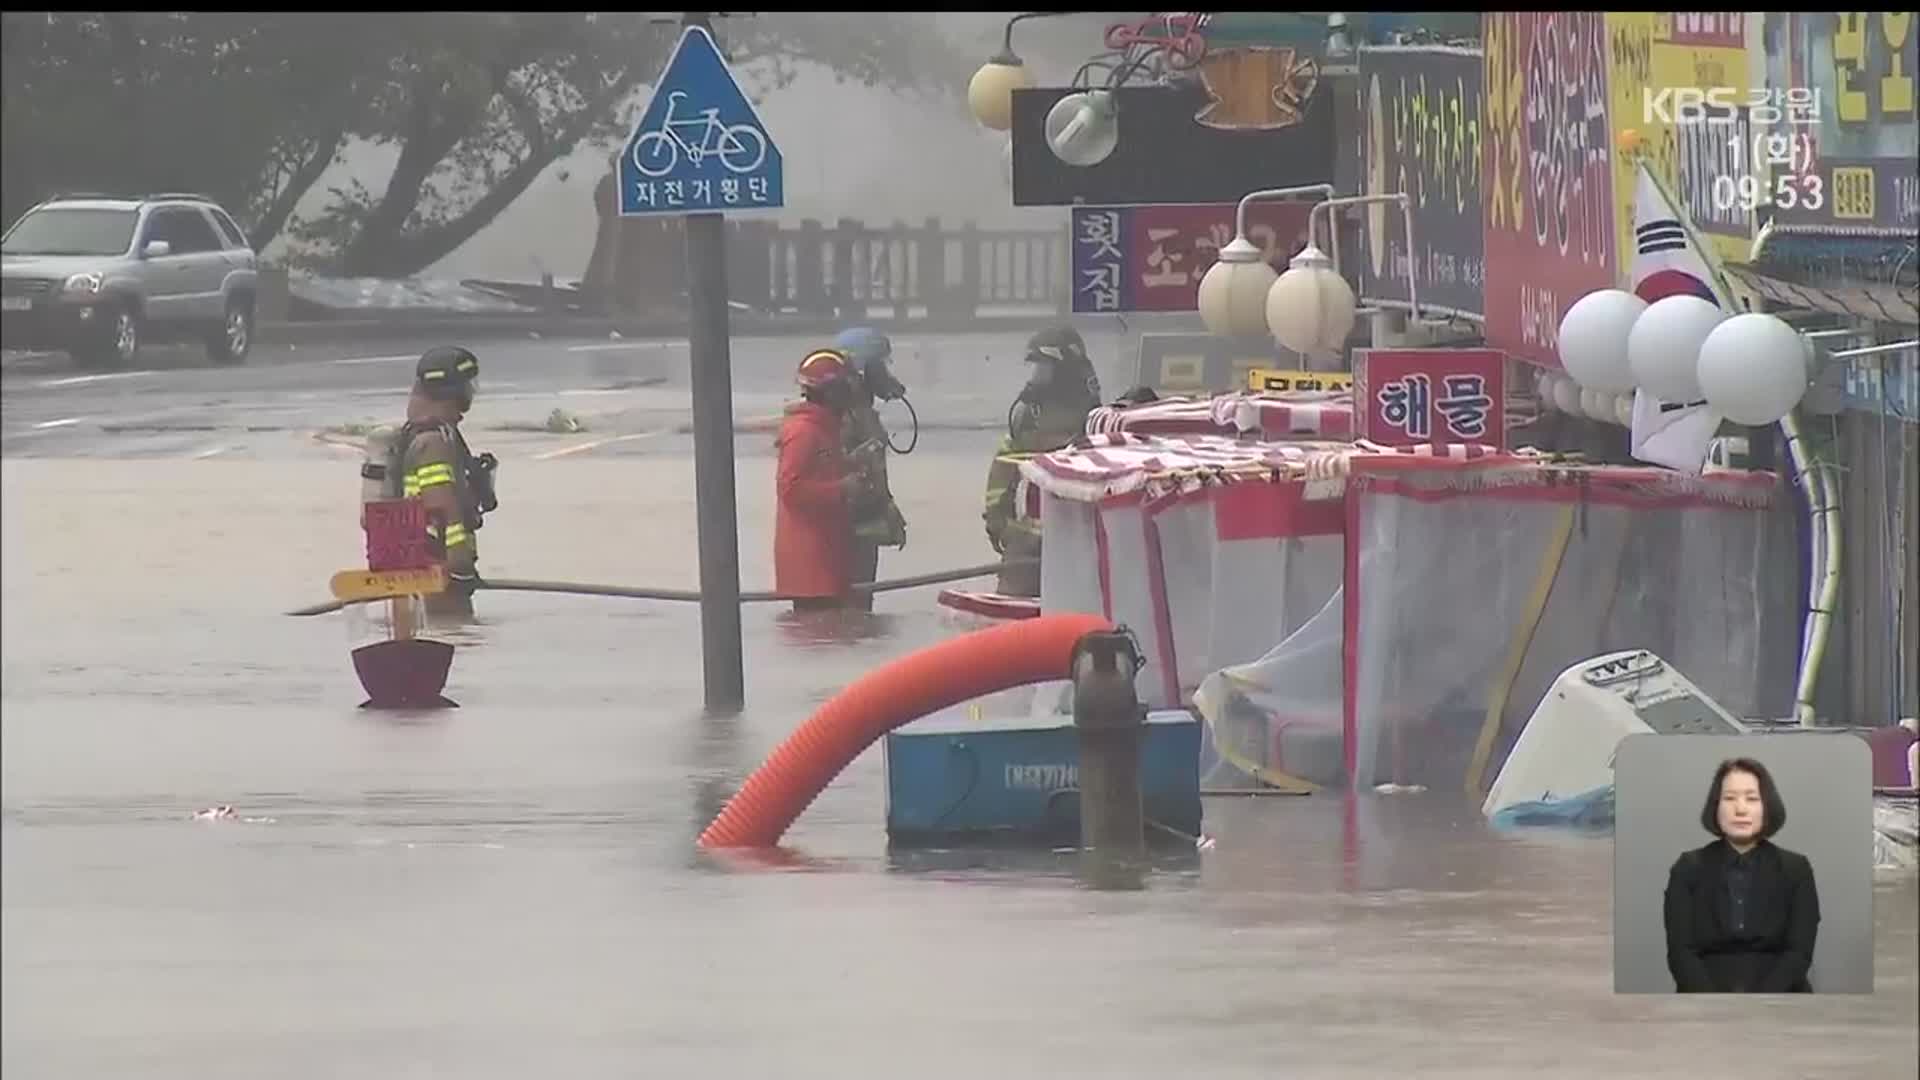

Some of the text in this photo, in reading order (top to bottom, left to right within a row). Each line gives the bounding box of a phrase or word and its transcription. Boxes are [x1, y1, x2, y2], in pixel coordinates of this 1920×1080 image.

[635, 176, 768, 206] 자전거횡단
[1080, 211, 1122, 310] 횟집
[1377, 373, 1494, 438] 해물
